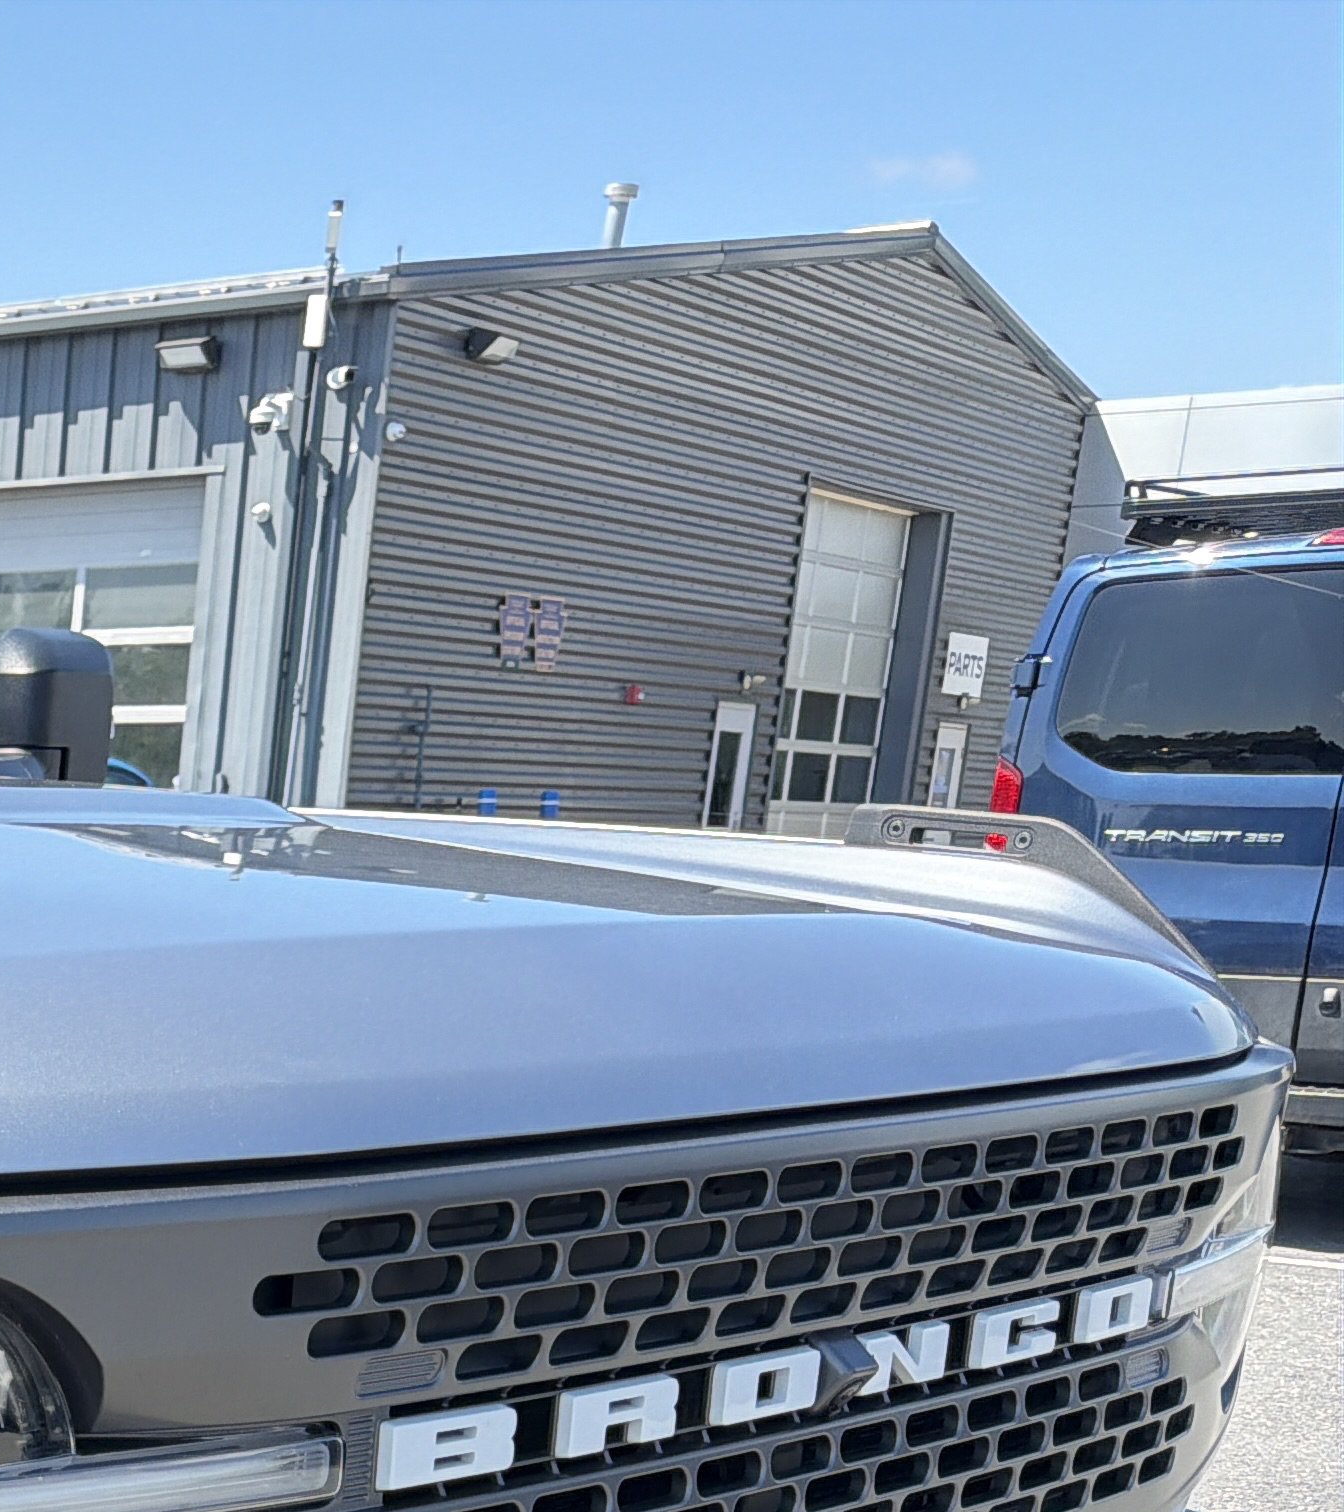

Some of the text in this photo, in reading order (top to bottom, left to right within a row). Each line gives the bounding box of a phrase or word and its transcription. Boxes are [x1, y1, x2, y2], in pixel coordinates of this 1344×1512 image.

[948, 651, 984, 679] PARTS
[1104, 829, 1285, 843] TRANSIT 350
[375, 1275, 1155, 1493] BRONCO
